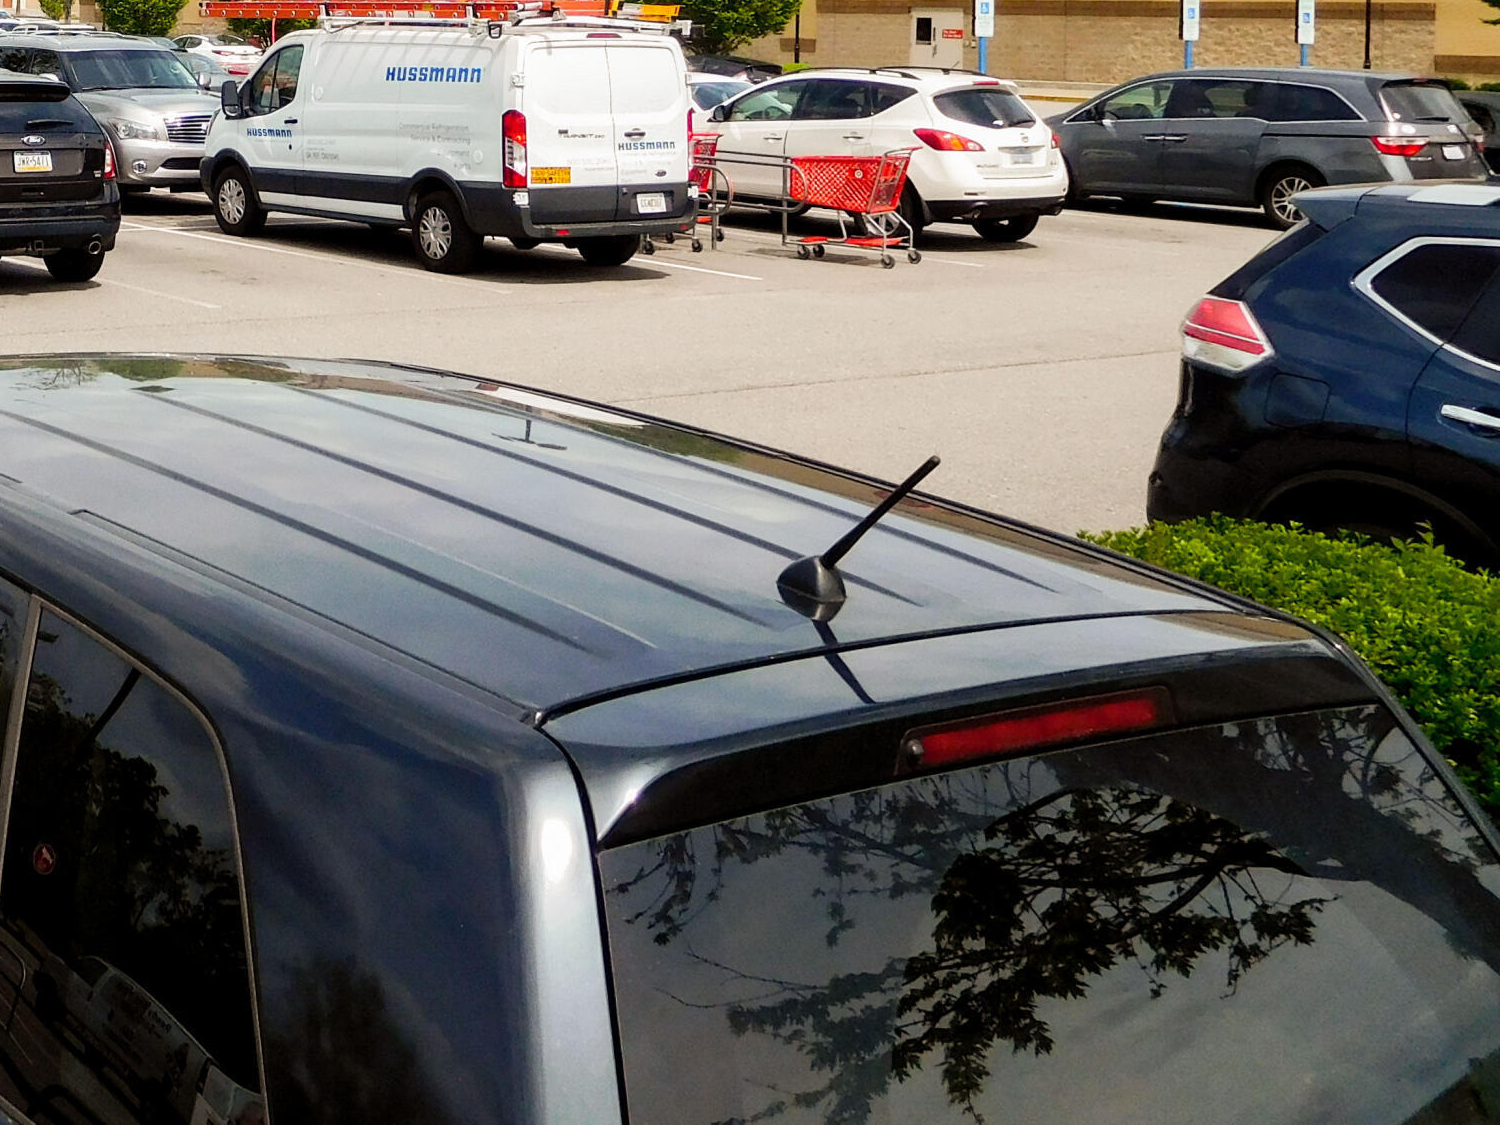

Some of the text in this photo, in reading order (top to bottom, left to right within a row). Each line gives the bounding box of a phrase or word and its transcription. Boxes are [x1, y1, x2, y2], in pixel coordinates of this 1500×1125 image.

[385, 66, 482, 83] HUSSMANN
[246, 128, 292, 138] HUSSMANN
[618, 141, 675, 151] HUSSMANN
